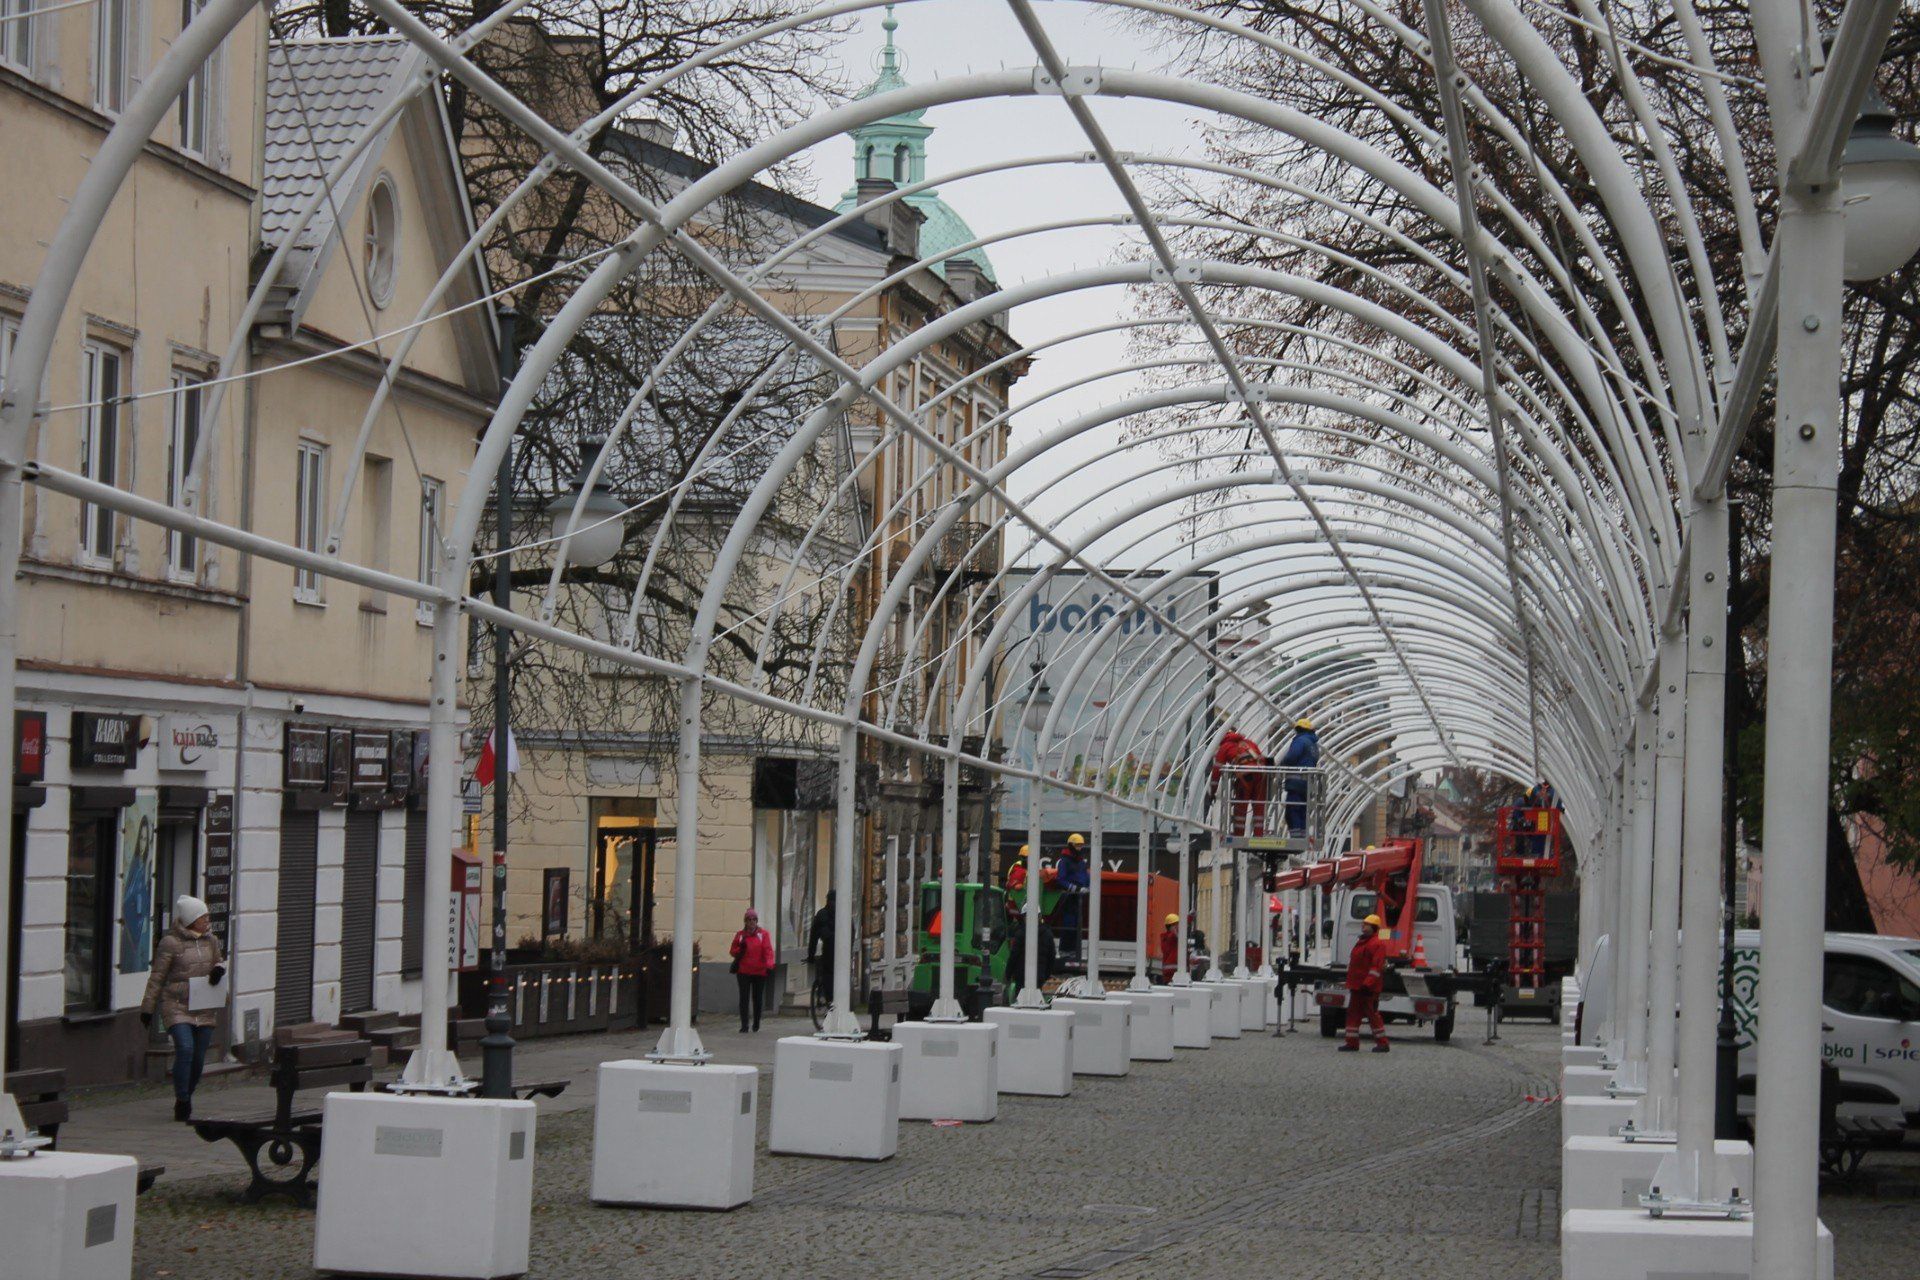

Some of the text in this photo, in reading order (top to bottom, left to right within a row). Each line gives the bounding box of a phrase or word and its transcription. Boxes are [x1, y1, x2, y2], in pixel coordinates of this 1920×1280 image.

[94, 718, 125, 743] KAREN
[93, 752, 126, 763] COLLECTION
[1821, 1042, 1854, 1058] bka
